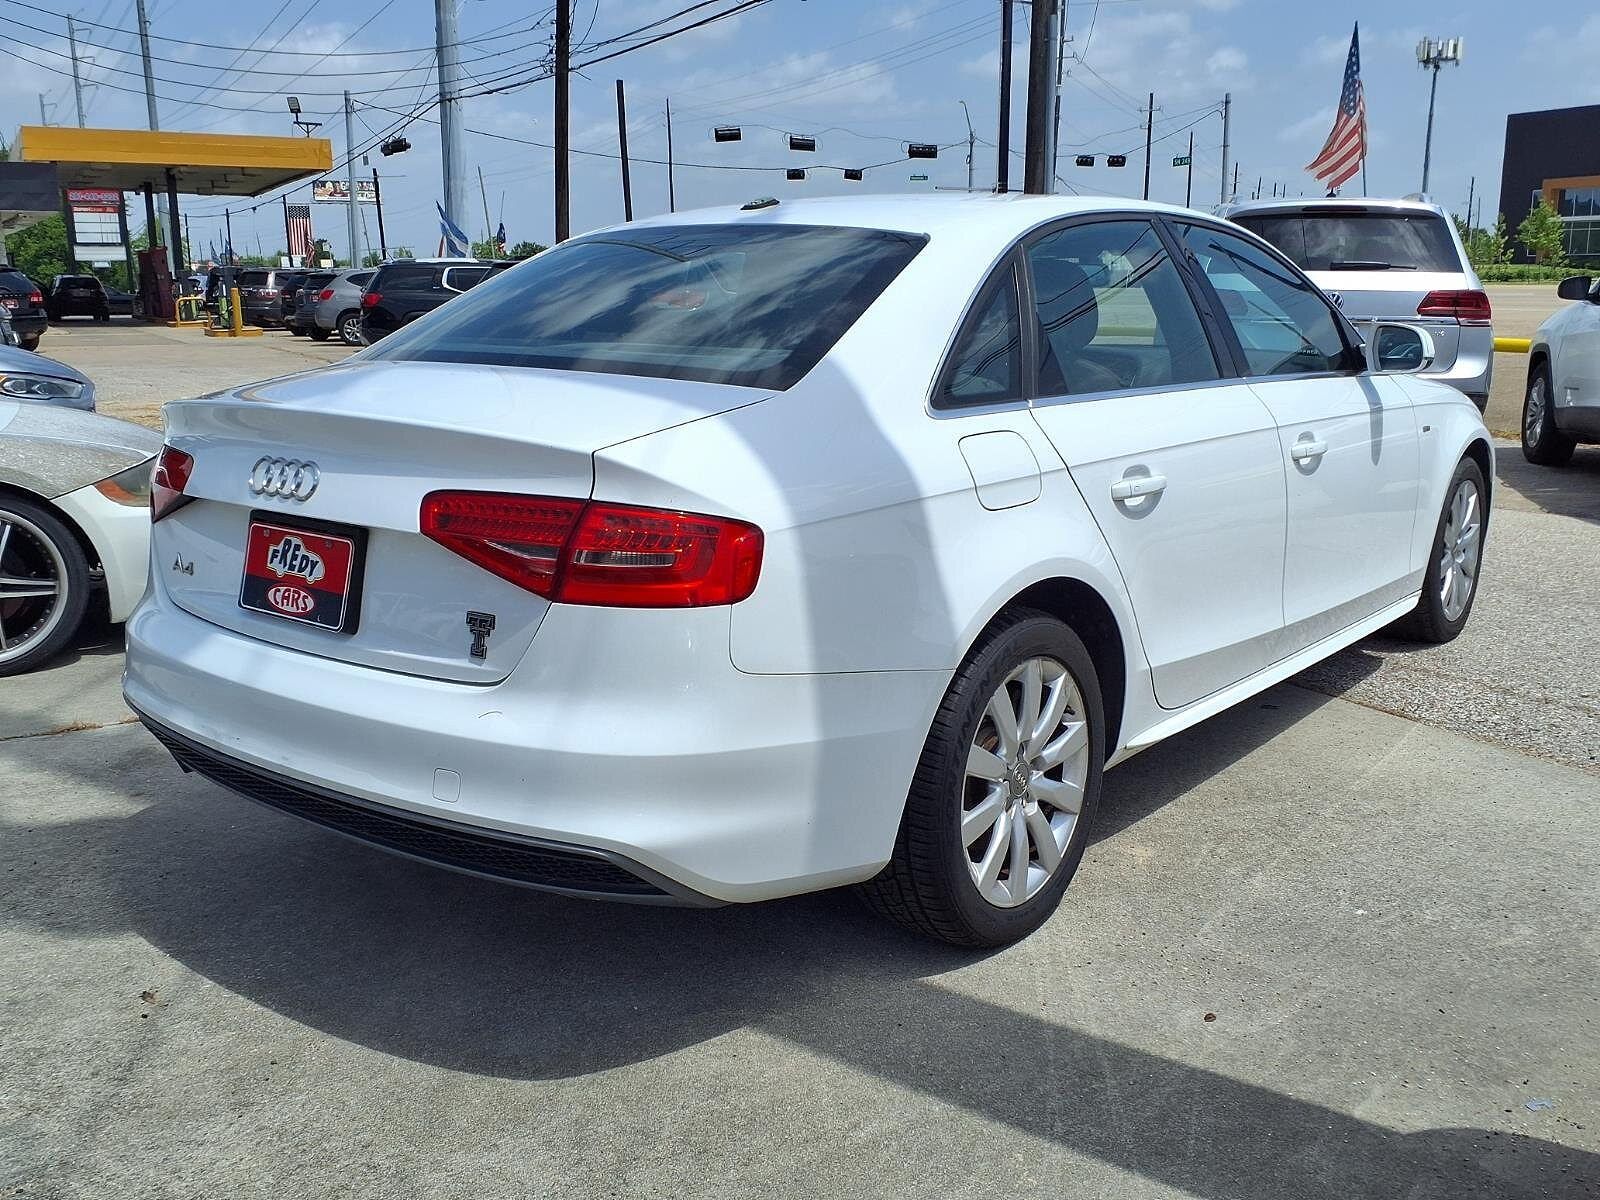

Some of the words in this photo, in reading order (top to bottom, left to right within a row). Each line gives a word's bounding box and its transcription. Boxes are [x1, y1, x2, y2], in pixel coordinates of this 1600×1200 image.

[172, 551, 194, 576] A4
[269, 538, 320, 577] FREDY
[273, 587, 309, 612] CARS
